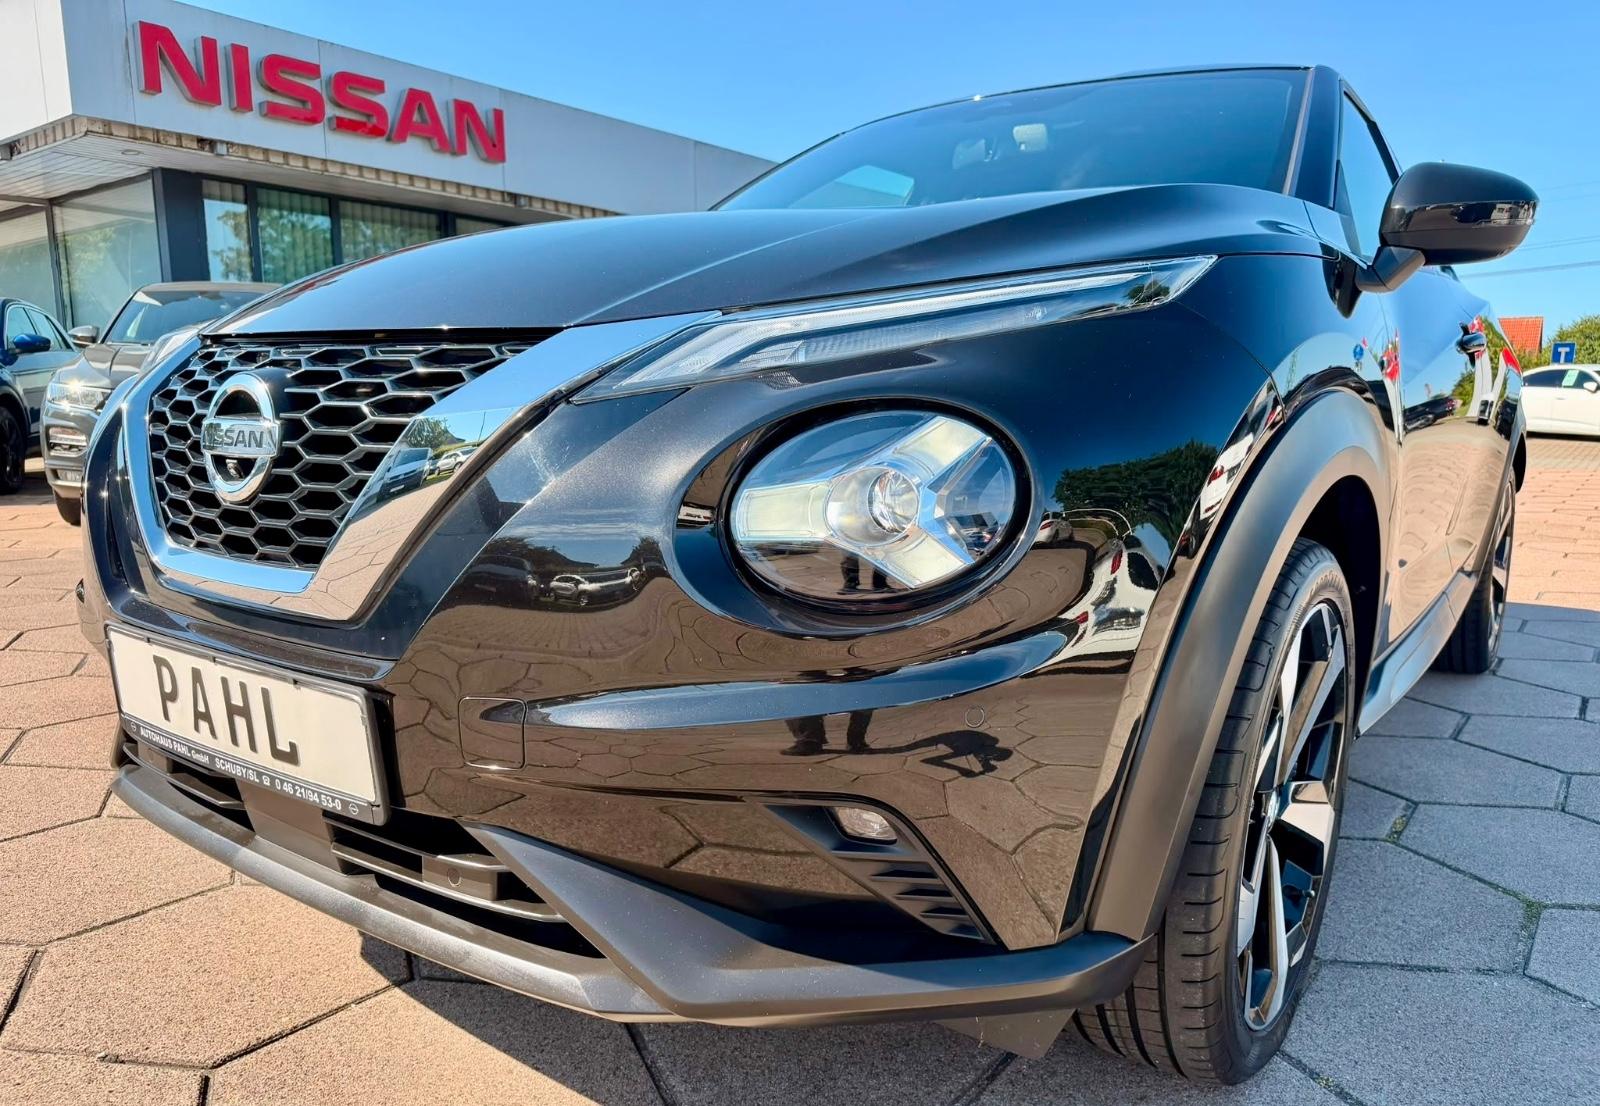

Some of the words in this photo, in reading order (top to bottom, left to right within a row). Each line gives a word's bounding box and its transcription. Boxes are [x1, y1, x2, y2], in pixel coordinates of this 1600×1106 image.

[134, 20, 506, 163] NISSAN
[152, 653, 300, 766] PAHL
[139, 726, 173, 750] AUTOHAUS
[173, 741, 191, 757] PAHL
[191, 750, 210, 765] GmbH
[214, 757, 260, 784] SCHUBY/SL
[283, 782, 295, 795] 46
[295, 786, 320, 804] 21/94
[320, 794, 342, 811] 53-0
